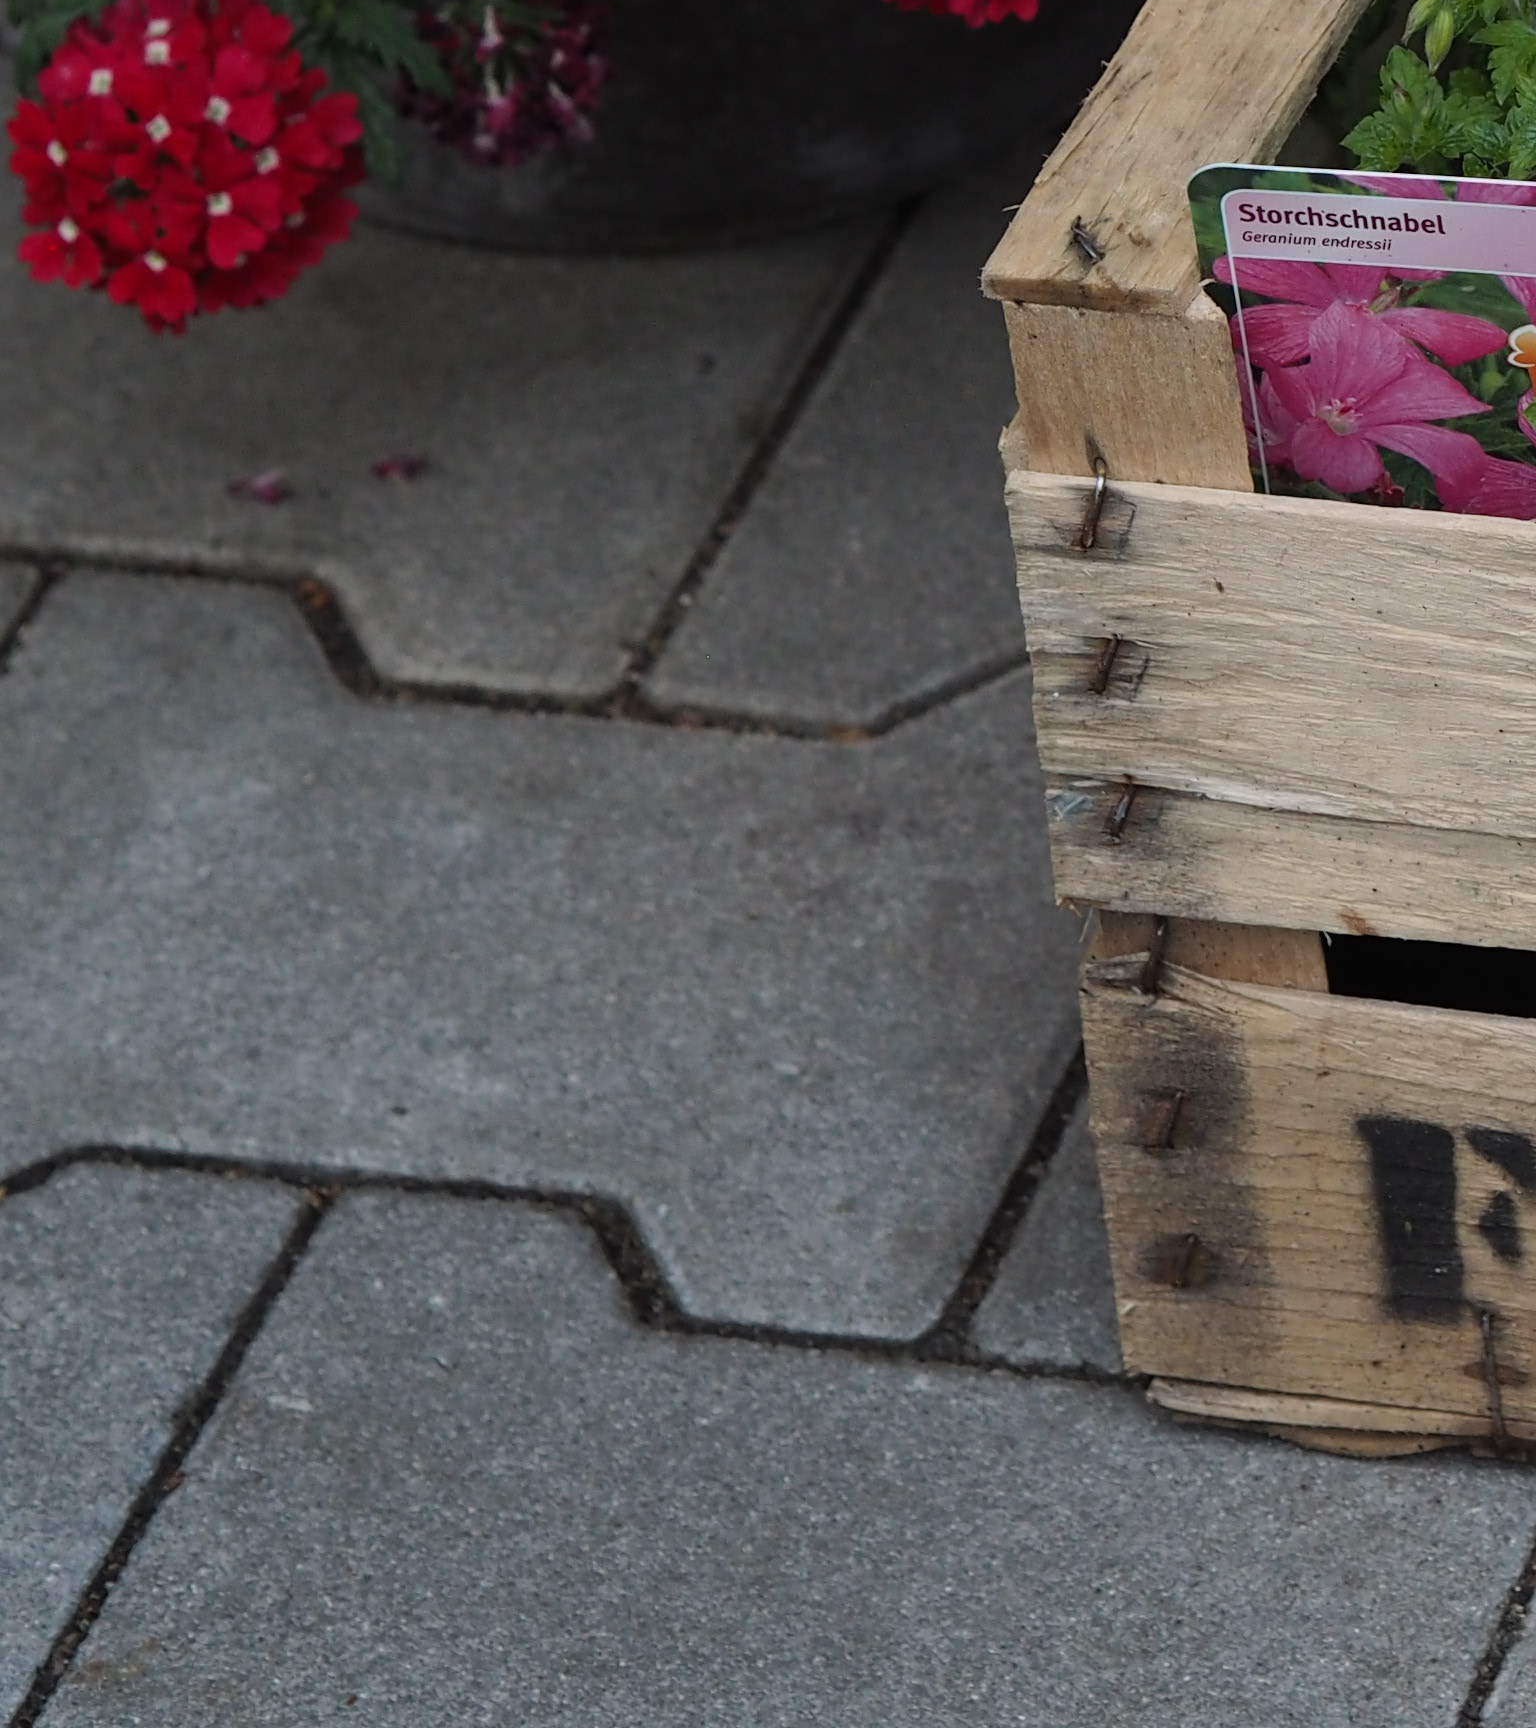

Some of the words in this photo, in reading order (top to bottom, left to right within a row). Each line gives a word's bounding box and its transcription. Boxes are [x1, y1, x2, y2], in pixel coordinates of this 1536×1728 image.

[1238, 203, 1447, 236] Storchschnabel
[1241, 230, 1318, 248] Geranium
[1321, 234, 1393, 252] endressii
